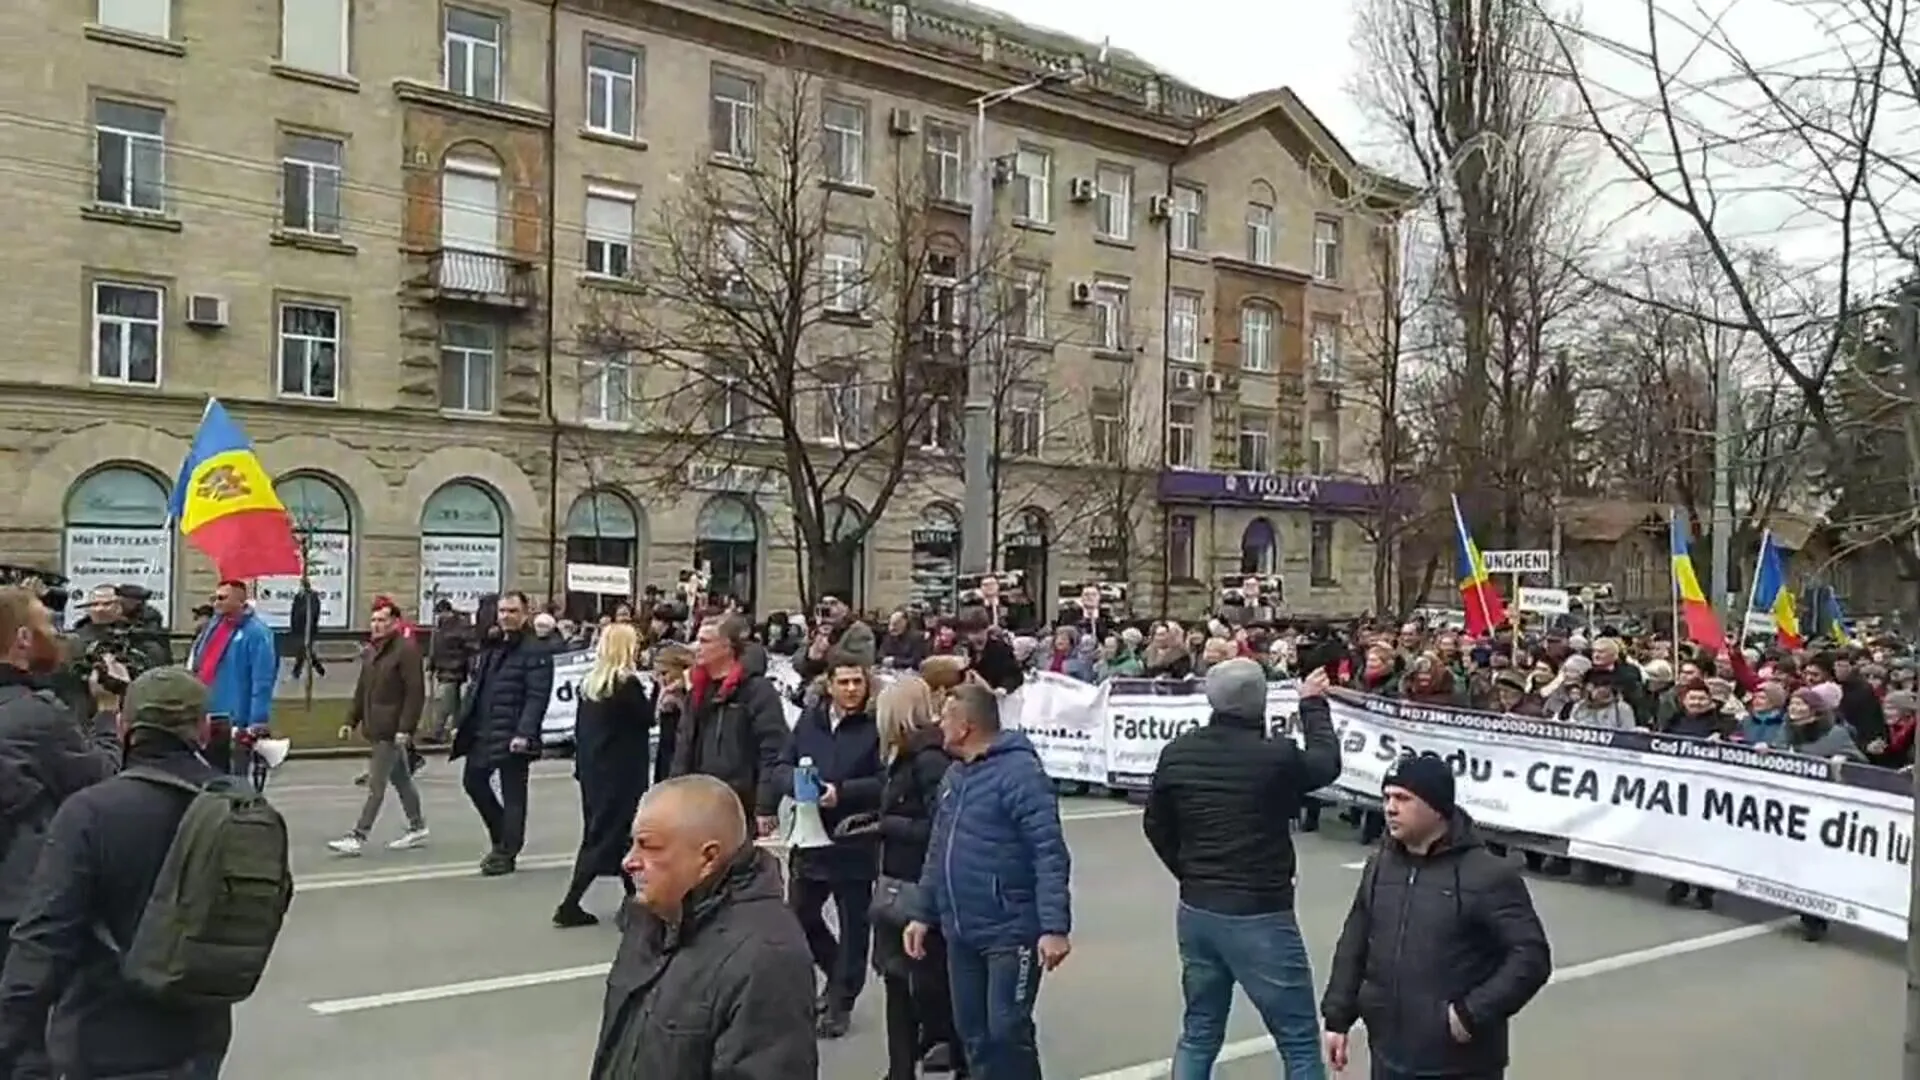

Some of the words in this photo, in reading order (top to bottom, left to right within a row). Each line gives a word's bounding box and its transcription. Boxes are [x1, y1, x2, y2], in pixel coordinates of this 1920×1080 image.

[1485, 553, 1547, 569] UNGHENI
[1526, 761, 1599, 802] CEA
[1611, 774, 1688, 816] MAI
[1702, 788, 1810, 841] MARE
[1819, 811, 1878, 857] din
